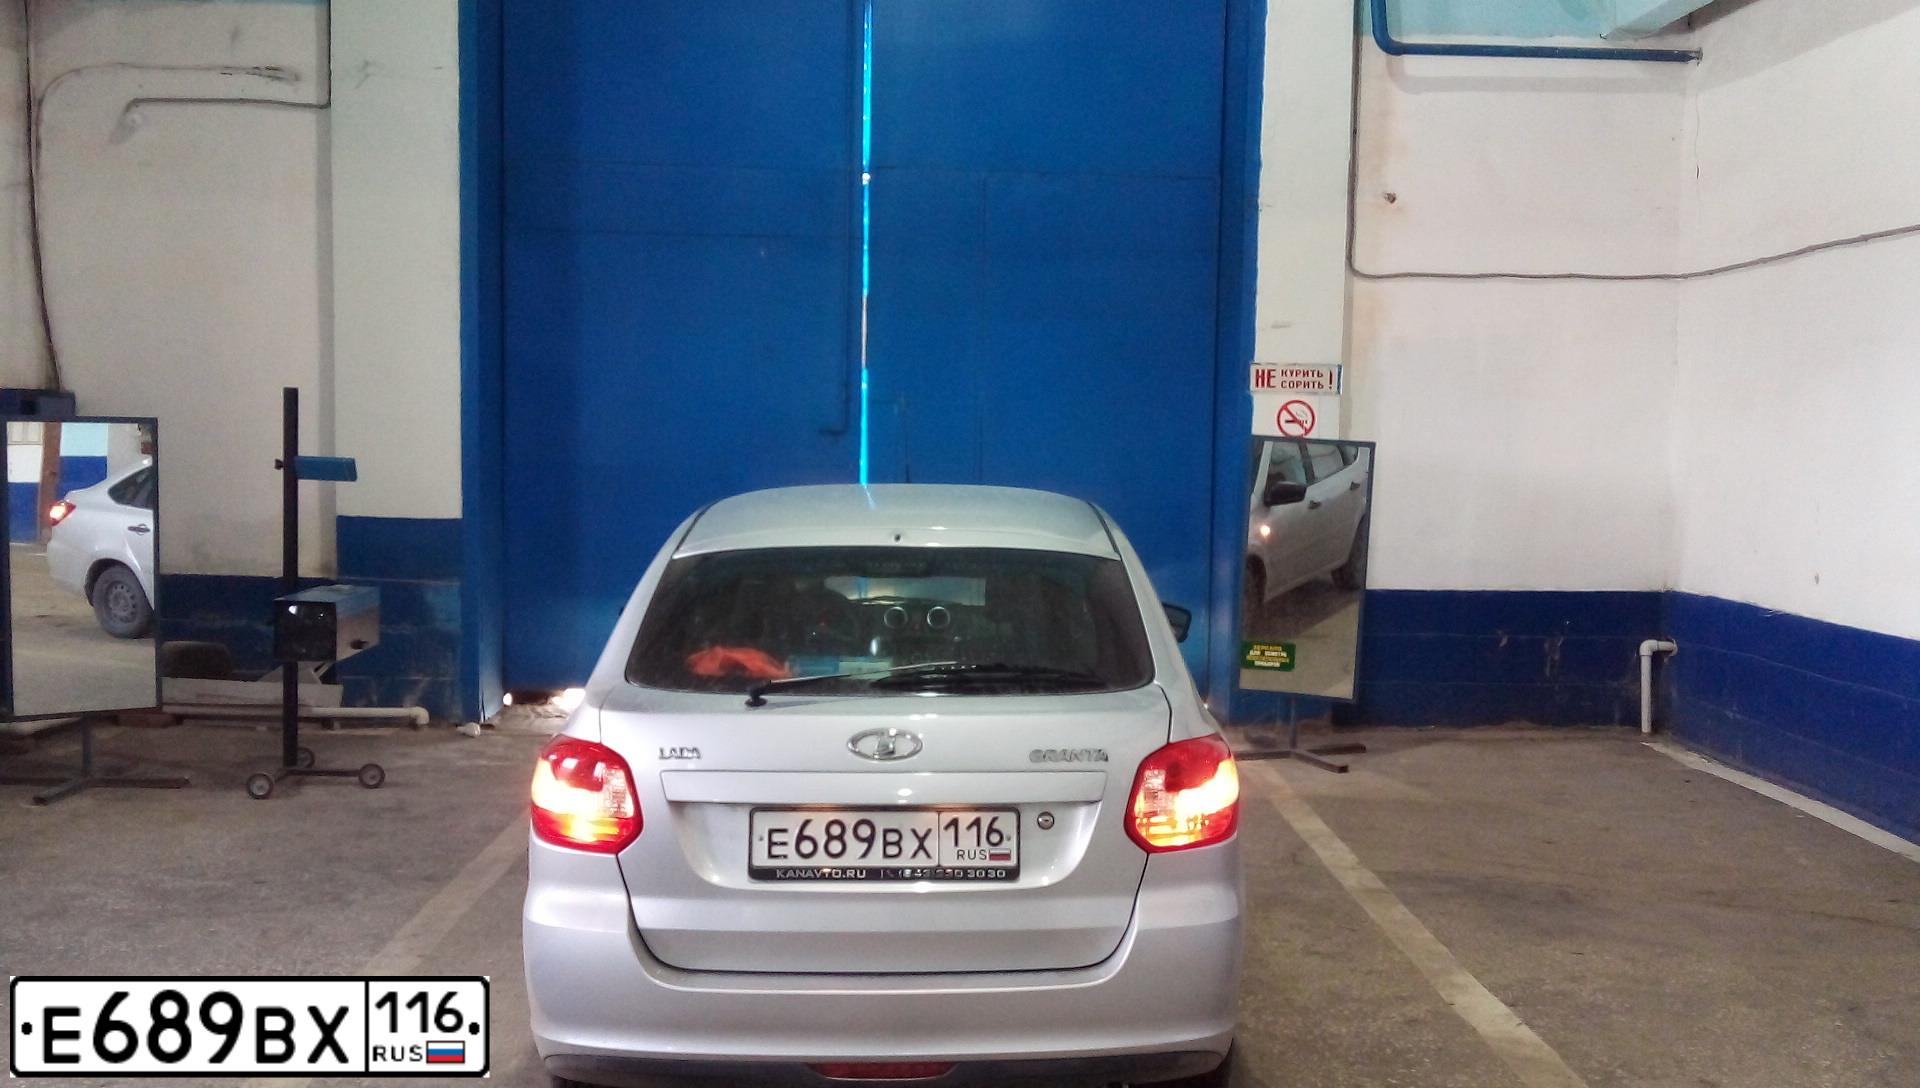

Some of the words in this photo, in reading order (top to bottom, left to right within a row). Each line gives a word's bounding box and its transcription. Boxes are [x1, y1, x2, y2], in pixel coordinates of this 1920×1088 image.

[1255, 368, 1277, 389] НЕ
[1280, 368, 1324, 379] КУРИТЬ
[1280, 380, 1324, 390] СОРИТЬ
[659, 747, 702, 760] LADA
[1029, 748, 1109, 763] GRANTA
[943, 816, 1005, 848] 116
[956, 849, 988, 861] RUS
[776, 868, 866, 879] KANAVTO.RU
